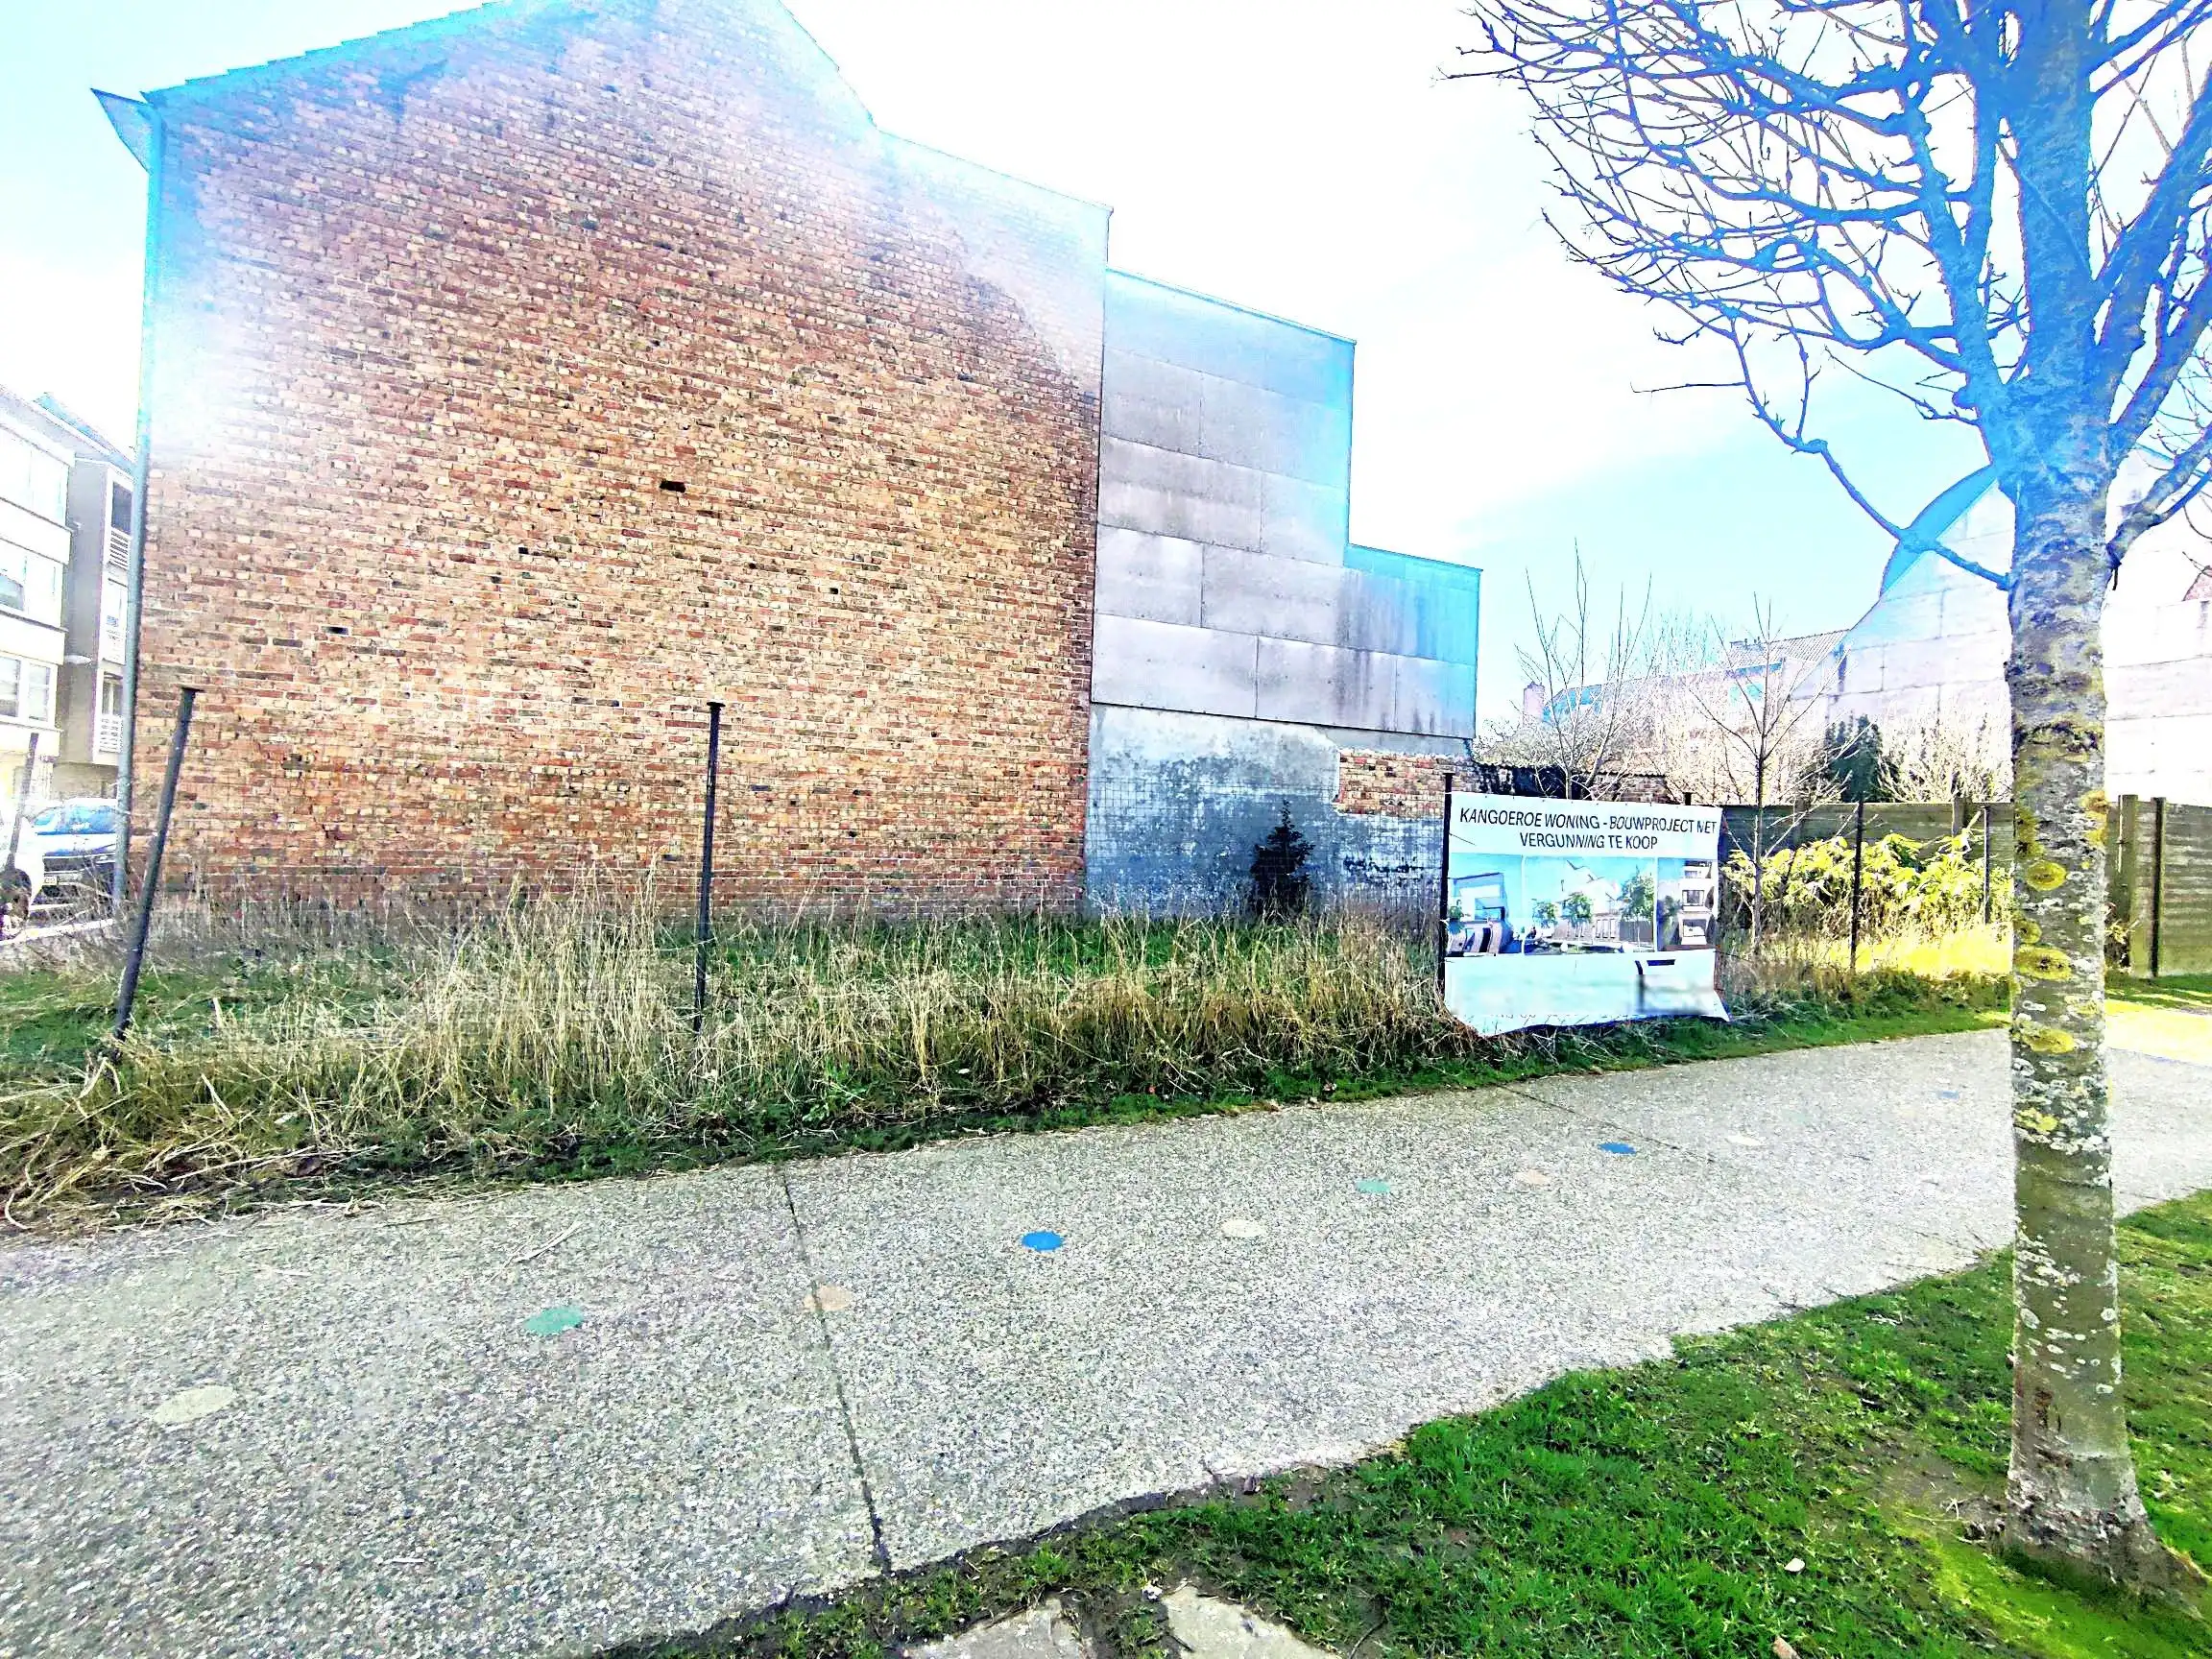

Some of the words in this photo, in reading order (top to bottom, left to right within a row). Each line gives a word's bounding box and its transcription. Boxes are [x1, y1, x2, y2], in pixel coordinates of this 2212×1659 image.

[1460, 807, 1542, 827] KANGOEROE
[1545, 813, 1600, 829] WONING
[1609, 816, 1695, 832] BOUWPROJECT
[1520, 832, 1604, 849] VERGUNNING
[1608, 834, 1623, 849] TE
[1625, 835, 1658, 850] KOOP
